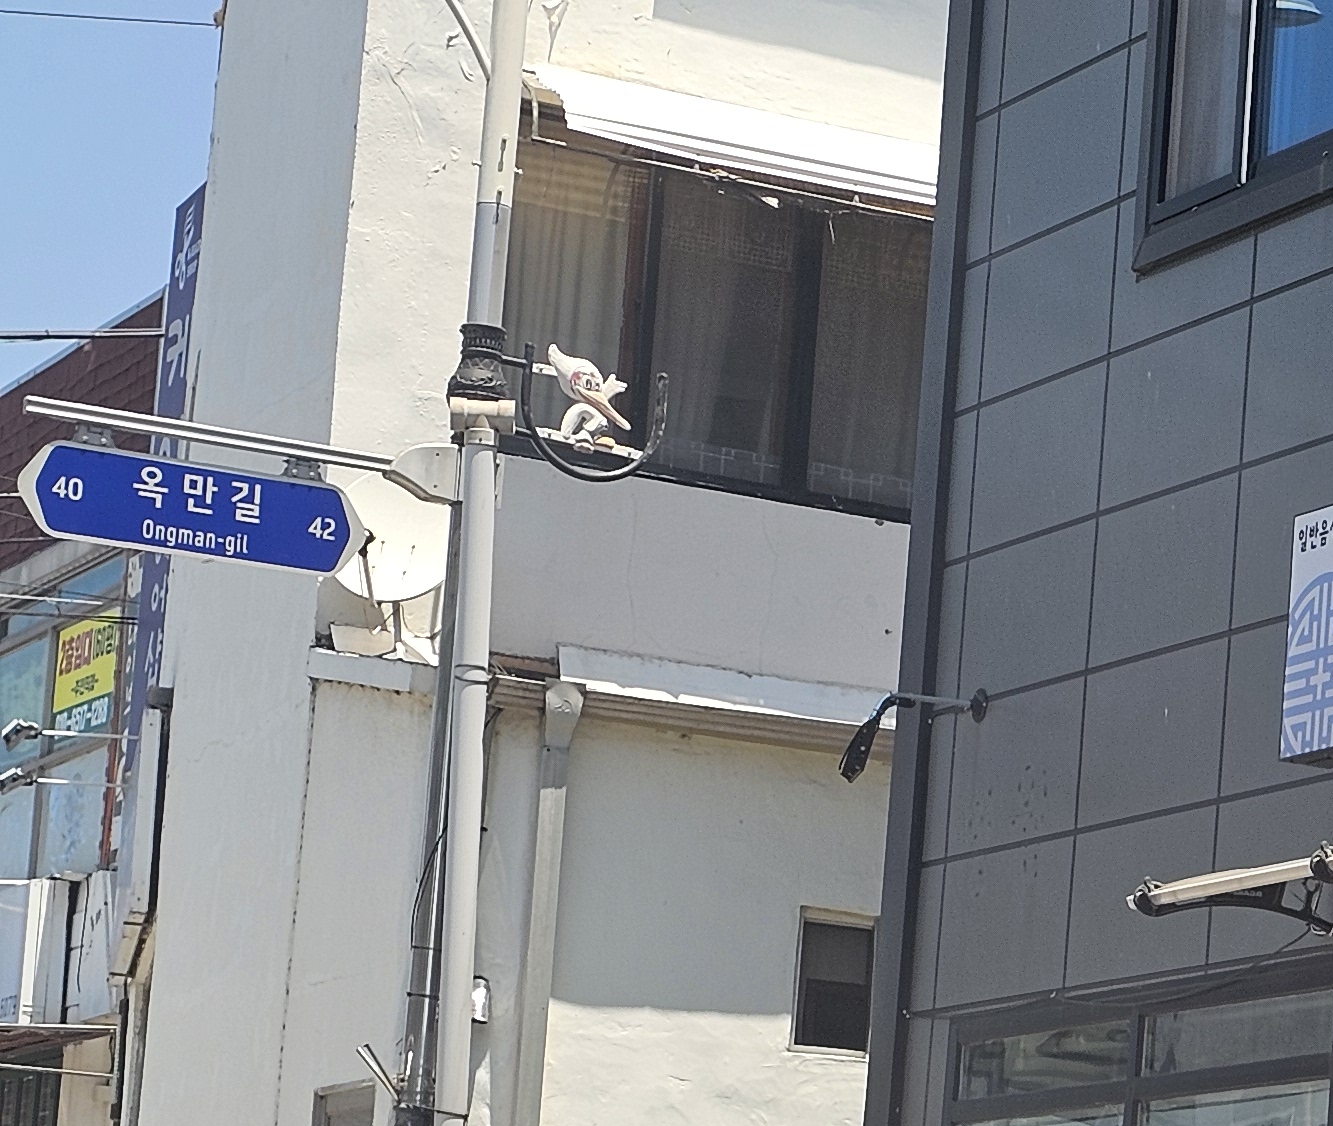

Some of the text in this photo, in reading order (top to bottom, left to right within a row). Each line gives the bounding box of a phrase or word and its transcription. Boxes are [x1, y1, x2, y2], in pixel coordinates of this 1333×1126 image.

[51, 476, 83, 501] 40
[133, 466, 262, 524] 옥만길
[142, 519, 249, 555] Ongman-gil
[308, 517, 336, 540] 42
